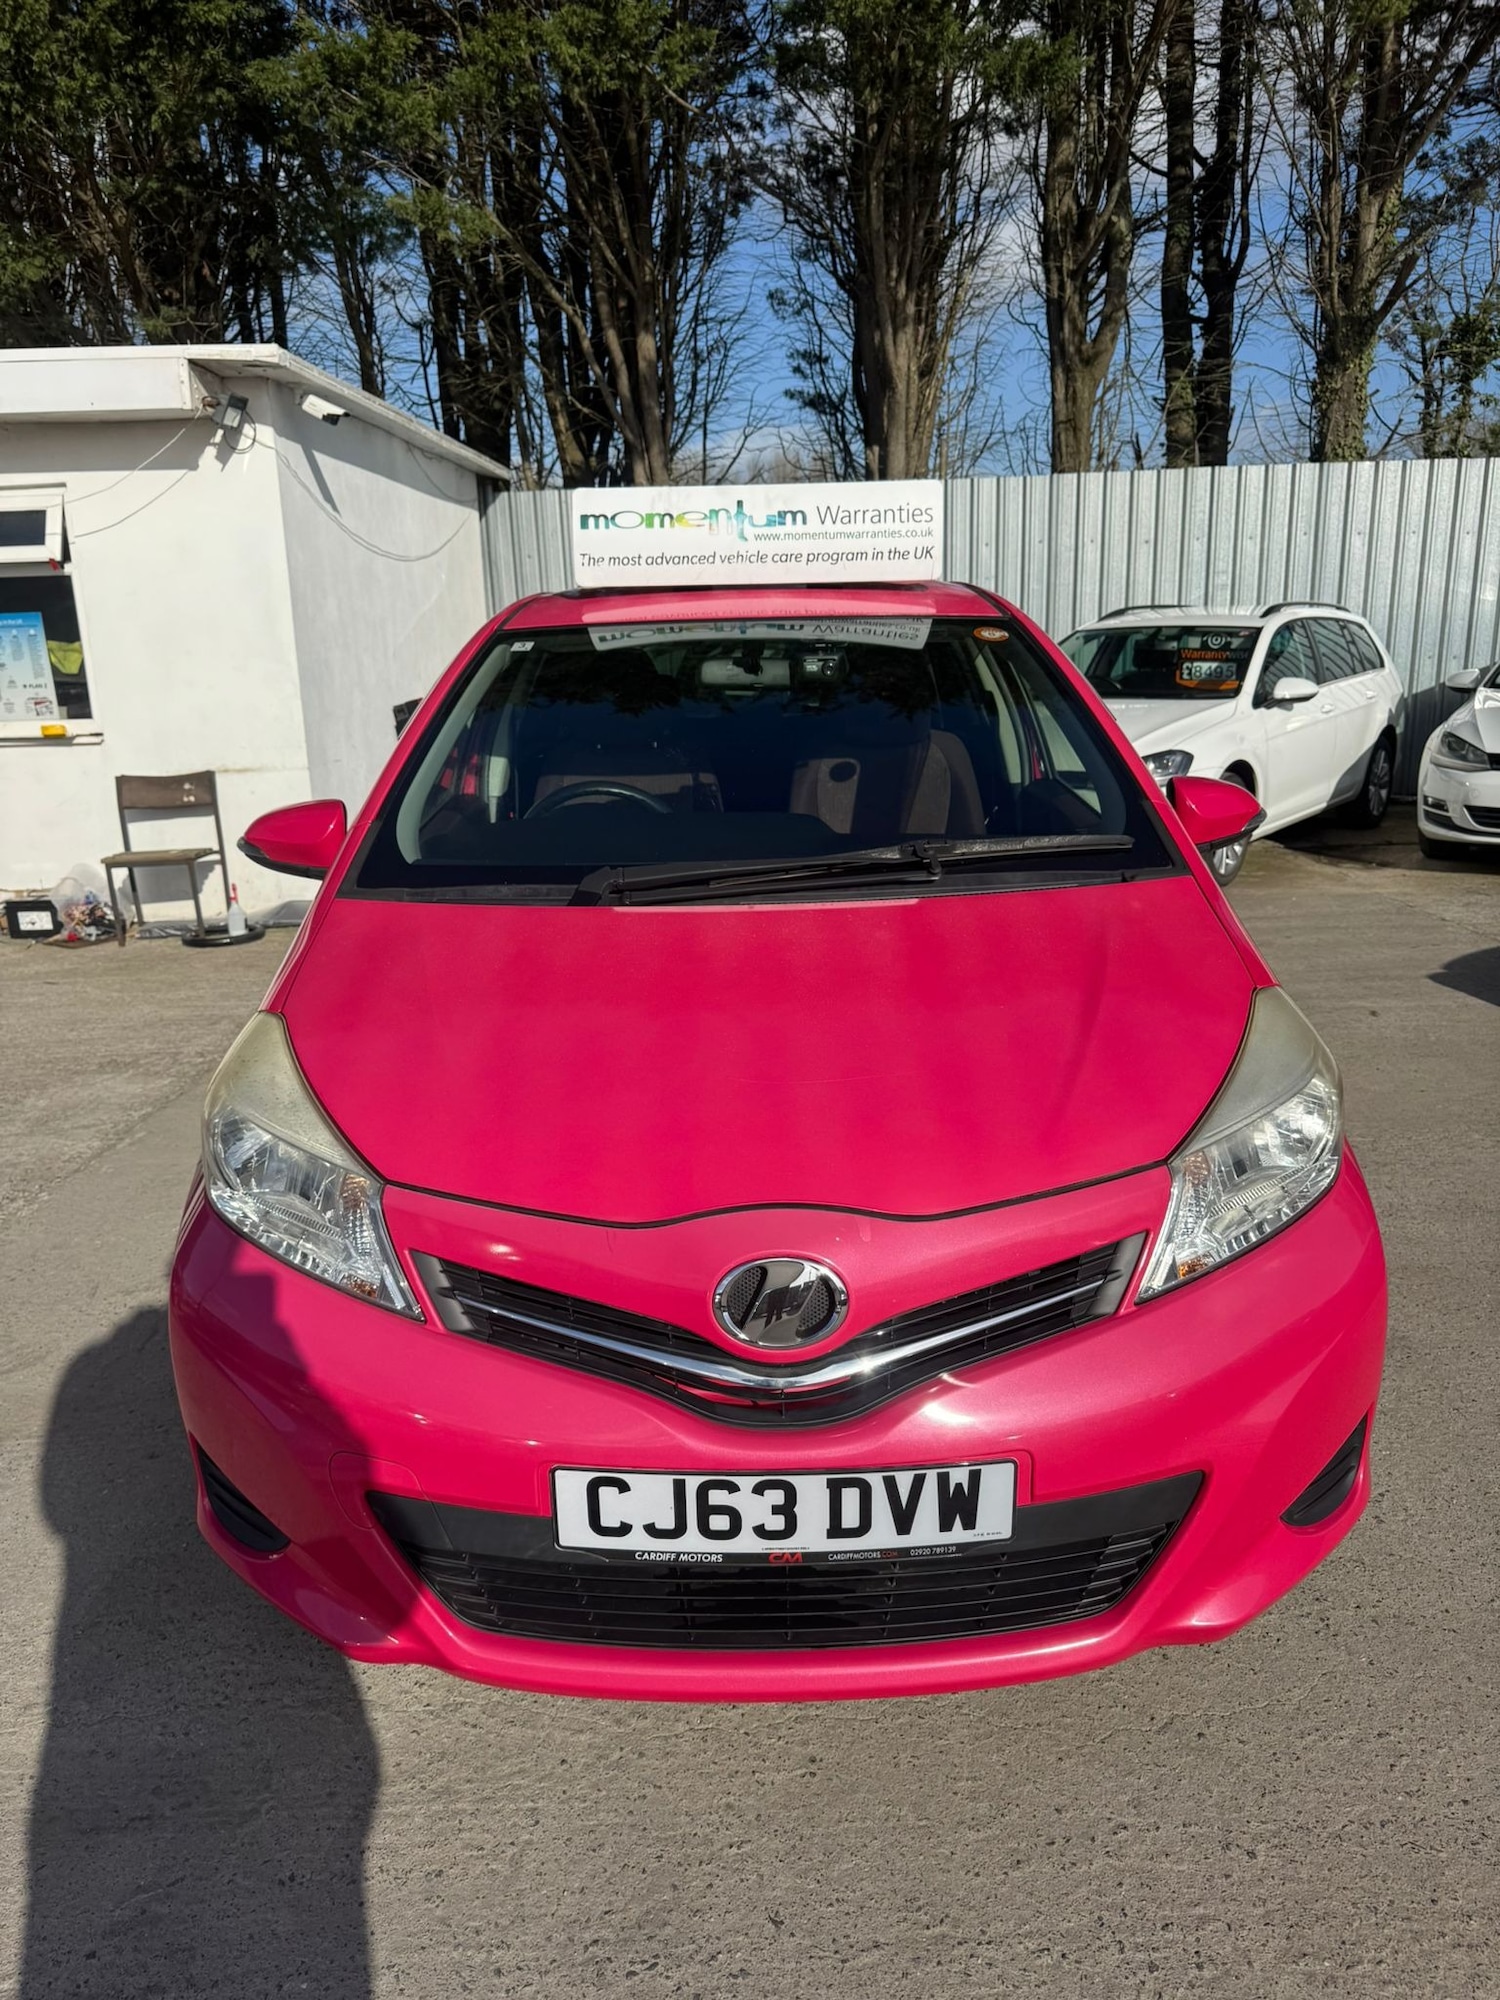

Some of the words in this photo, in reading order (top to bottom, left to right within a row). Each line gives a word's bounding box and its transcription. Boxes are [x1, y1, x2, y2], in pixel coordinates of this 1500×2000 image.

[580, 499, 807, 542] momentum
[816, 502, 934, 525] Warranties
[754, 528, 934, 541] www.momentumwarranties.co.uk
[580, 553, 605, 566] The
[608, 553, 642, 566] most
[645, 551, 716, 566] advanced
[719, 550, 769, 565] vehicle
[771, 551, 803, 563] care
[806, 551, 868, 566] program
[871, 547, 884, 561] in
[888, 547, 910, 561] the
[913, 546, 935, 560] UK
[586, 1476, 798, 1541] CJ63
[826, 1469, 982, 1540] DVW
[635, 1551, 676, 1561] CARDIFF
[678, 1553, 723, 1563] MOTORS
[768, 1552, 803, 1563] CM
[910, 1548, 932, 1556] 02920
